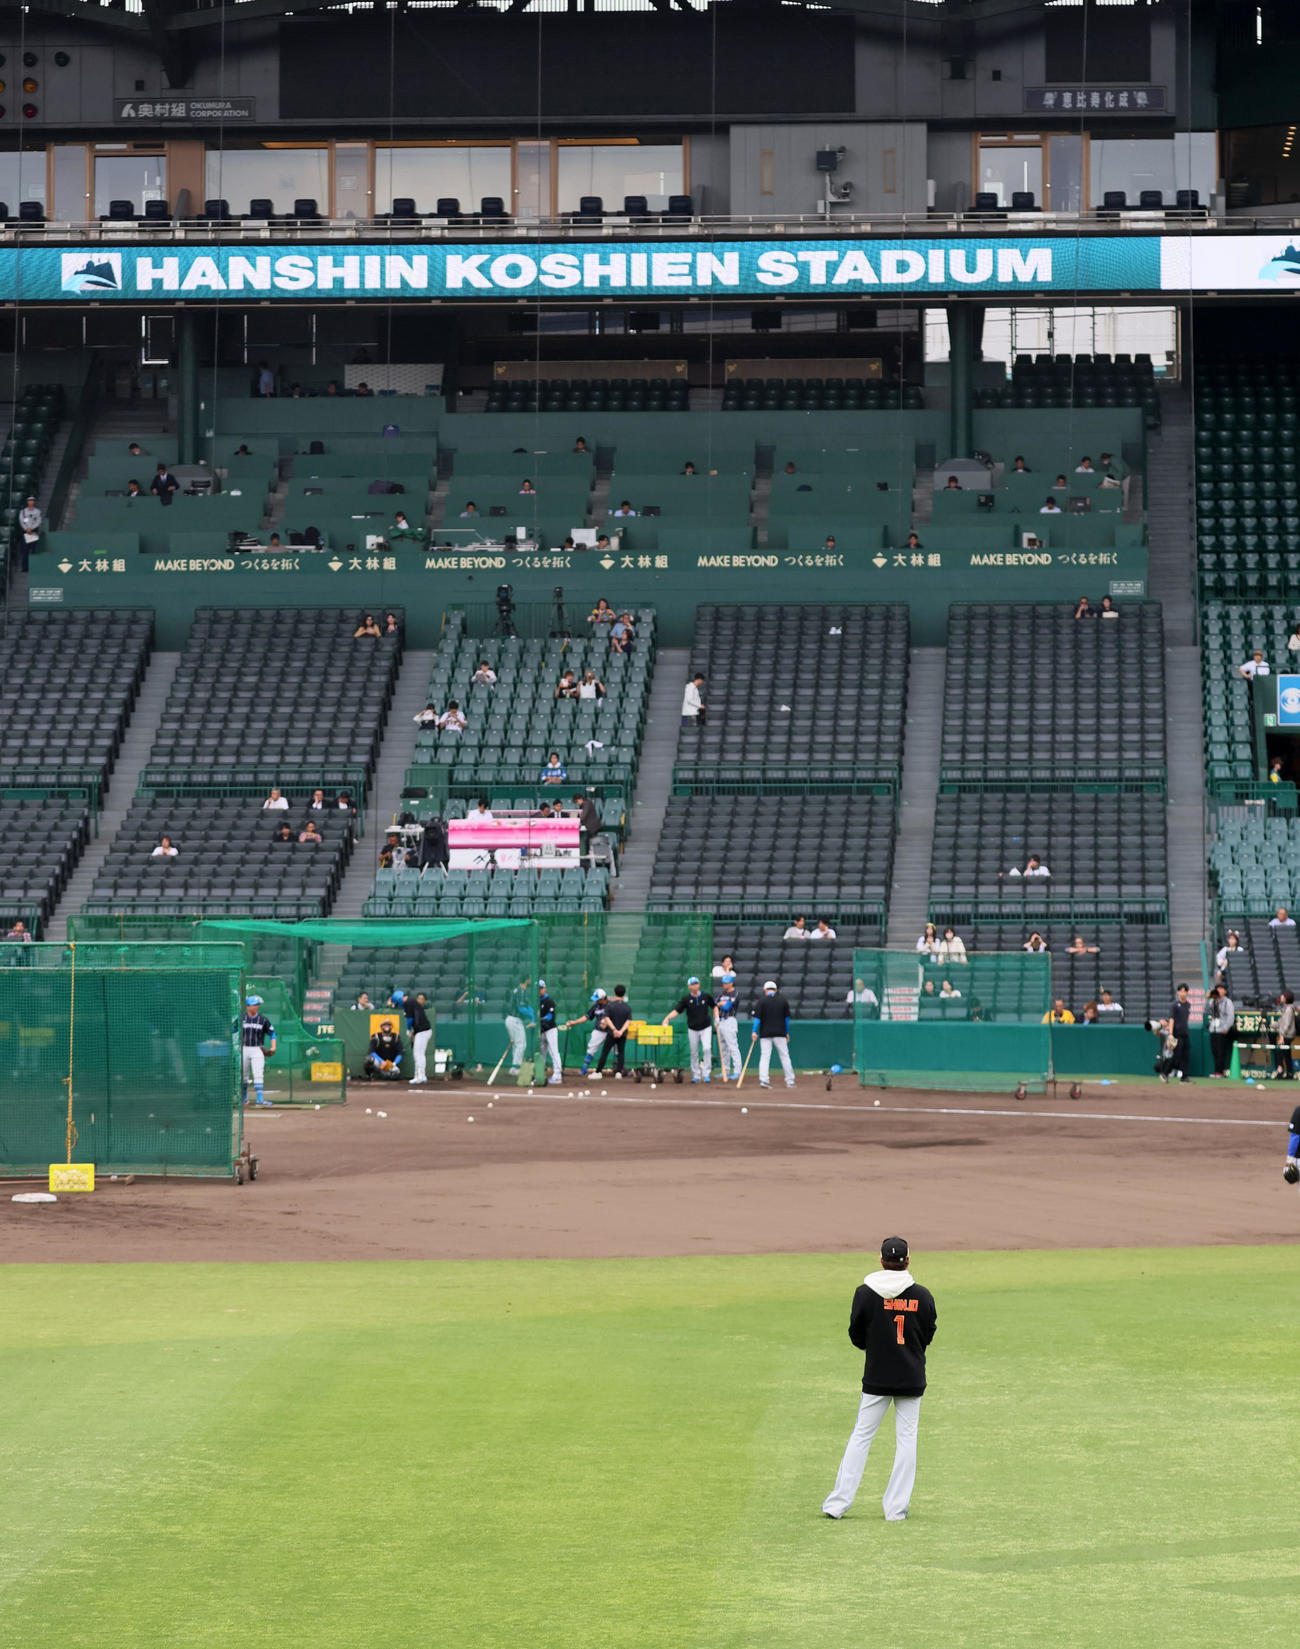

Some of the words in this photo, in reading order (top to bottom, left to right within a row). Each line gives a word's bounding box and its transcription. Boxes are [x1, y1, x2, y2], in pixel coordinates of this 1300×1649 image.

[138, 103, 187, 118] 奥村組
[136, 255, 428, 290] HANSHIN
[446, 251, 739, 289] KOSHIEN
[756, 248, 1053, 286] STADIUM
[78, 558, 126, 572] 大林組
[154, 559, 187, 571] MAKE
[189, 559, 235, 571] BEYOND
[241, 558, 299, 570] つくるを拓く
[349, 557, 396, 570] 大林組
[425, 557, 458, 569] MAKE
[459, 557, 506, 569] BEYOND
[512, 556, 571, 568] つくるを拓く
[621, 555, 668, 568] 大林組
[697, 556, 730, 567] MAKE
[732, 556, 778, 567] BEYOND
[784, 554, 843, 566] つくるを拓く
[893, 554, 941, 567] 大林組
[970, 553, 1003, 565] MAKE
[1005, 553, 1052, 565] BEYOND
[1057, 553, 1117, 565] つくるを拓く
[883, 1299, 919, 1312] SHINJO
[893, 1315, 905, 1345] 1
